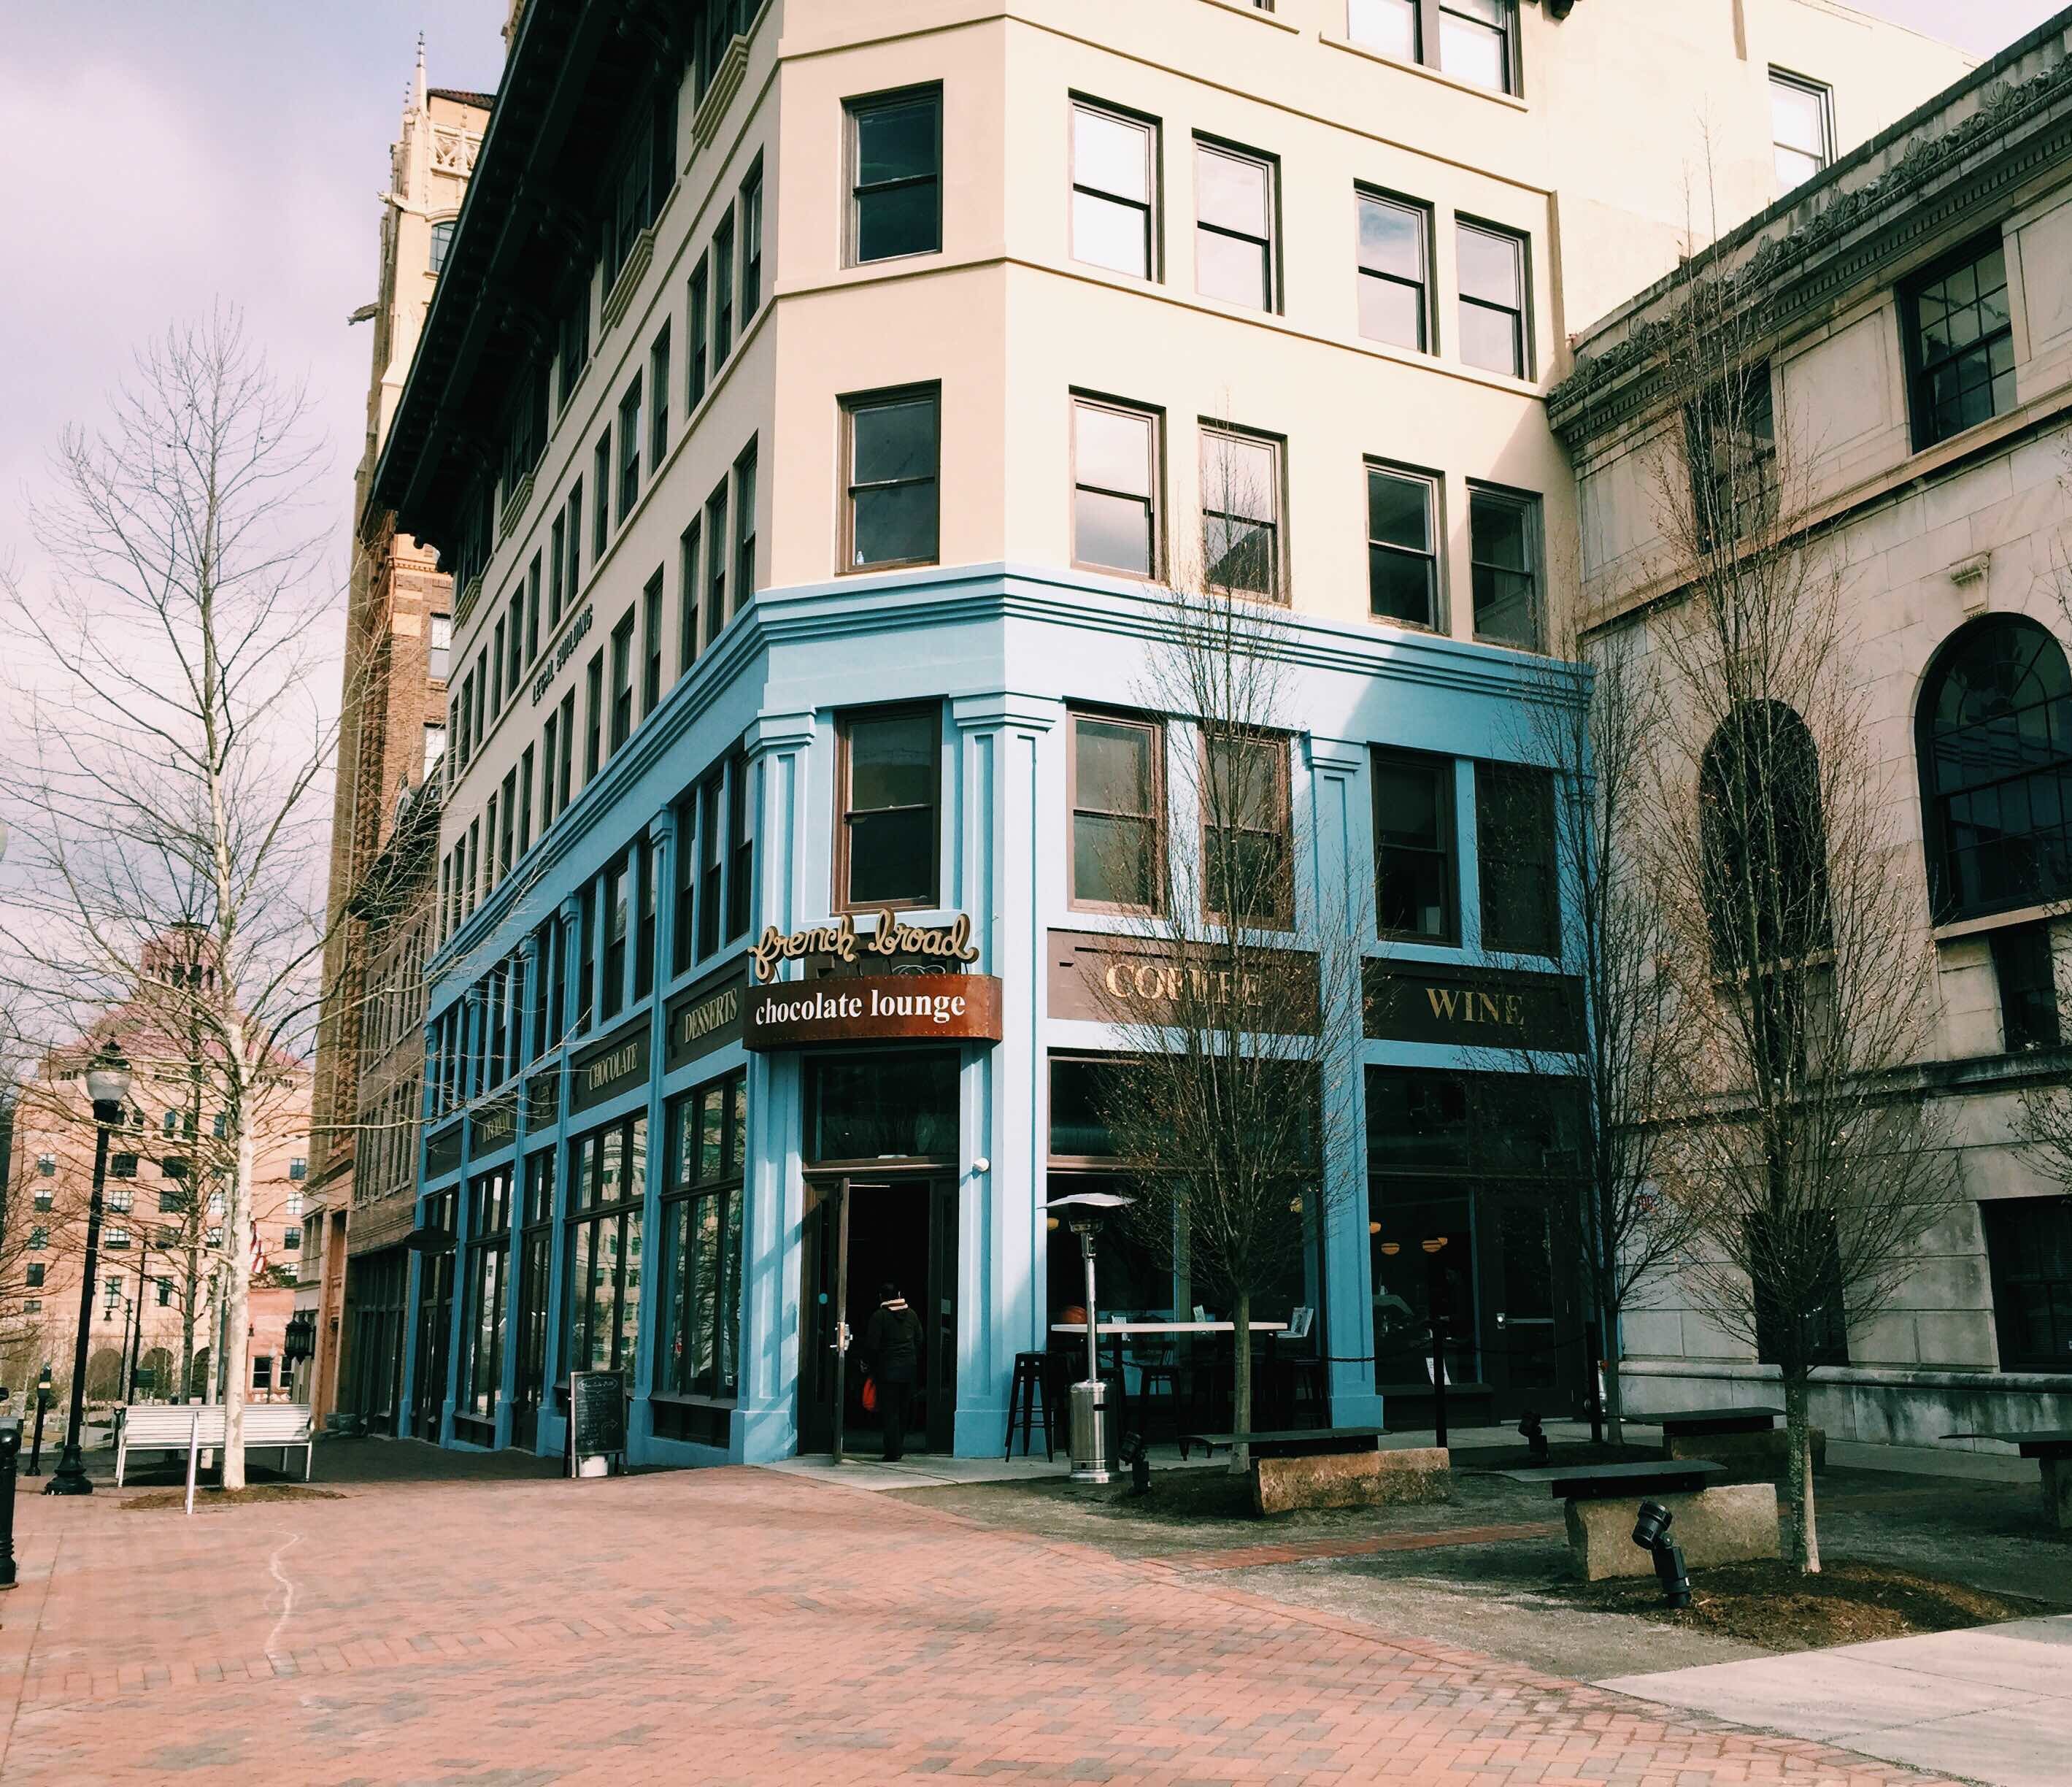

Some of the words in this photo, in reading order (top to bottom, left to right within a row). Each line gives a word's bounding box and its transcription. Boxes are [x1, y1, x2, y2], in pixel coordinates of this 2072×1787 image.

[557, 603, 593, 672] BUILDING
[747, 912, 860, 983] french
[868, 905, 980, 964] broad
[683, 987, 738, 1044] DESSERTS
[755, 992, 863, 1026] chocolate
[870, 989, 966, 1023] lounge
[1425, 987, 1525, 1026] WINE
[588, 1042, 639, 1091] CHOCOLATE
